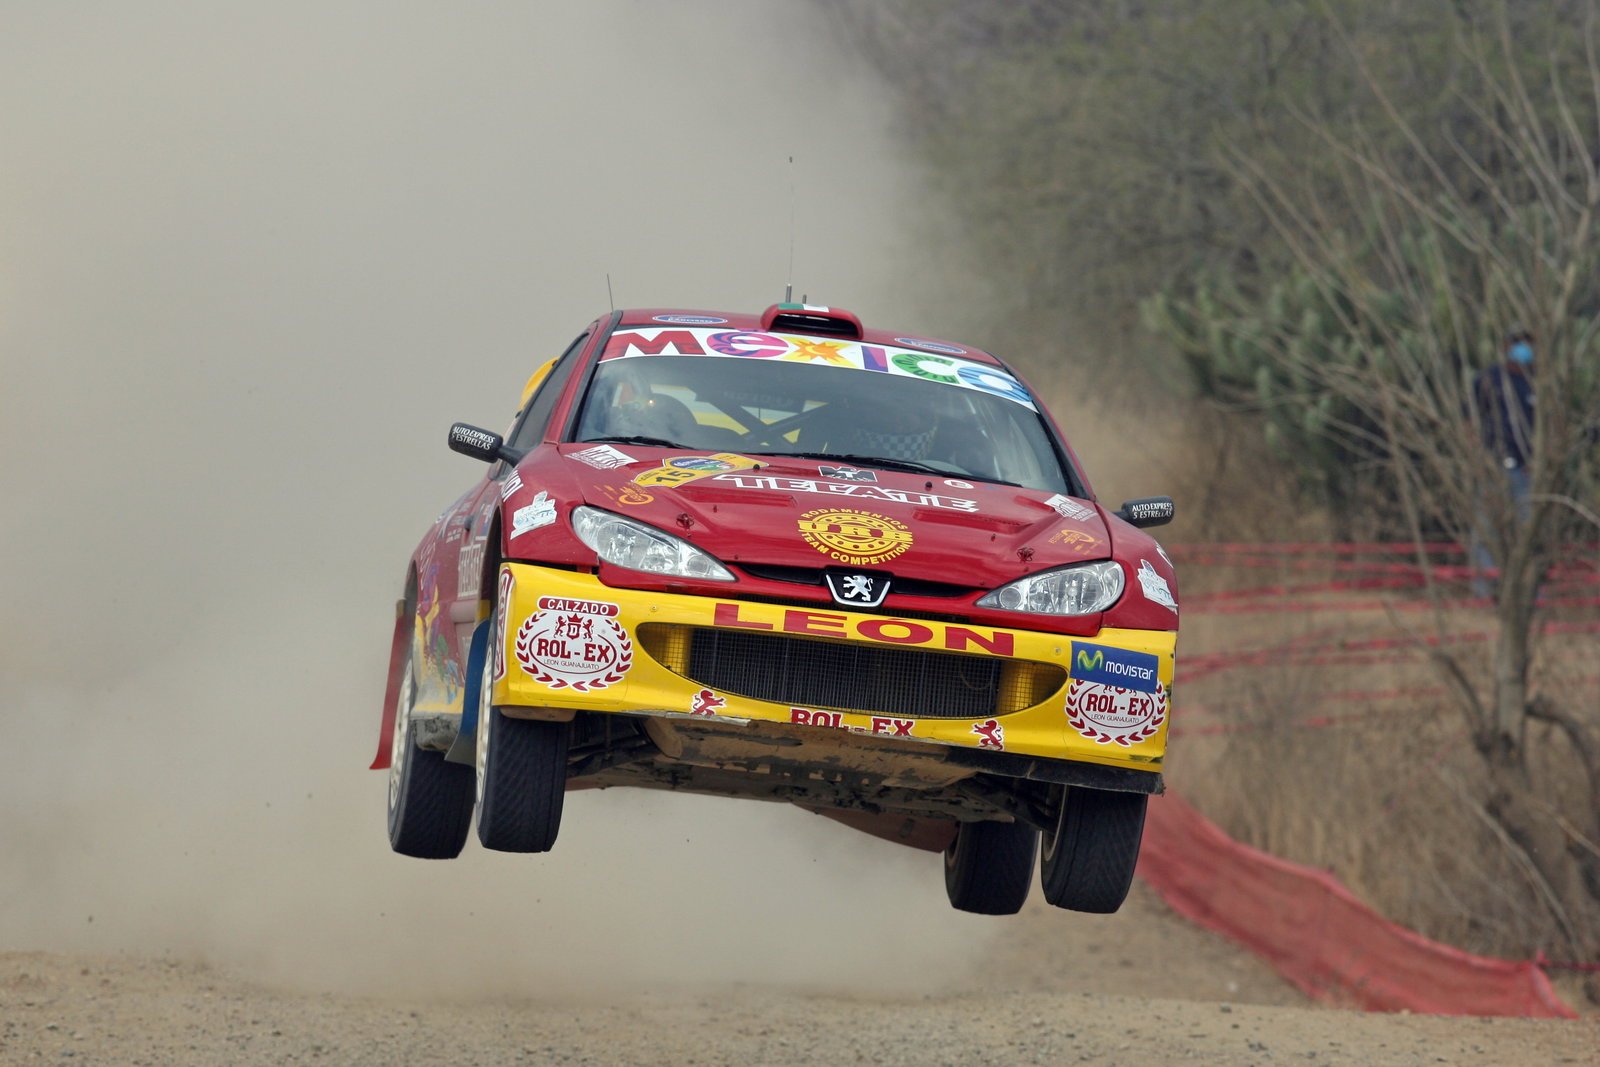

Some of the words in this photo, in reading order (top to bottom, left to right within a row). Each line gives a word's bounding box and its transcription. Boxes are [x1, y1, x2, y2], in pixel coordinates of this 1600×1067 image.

[655, 470, 695, 483] 15
[801, 508, 908, 530] RODAMIENTOS
[802, 533, 829, 554] TEAM
[831, 541, 914, 565] COMPETITION
[547, 599, 609, 615] CALZADO
[560, 660, 600, 670] GUANAJUATO
[1106, 715, 1140, 723] GUANAJUATO
